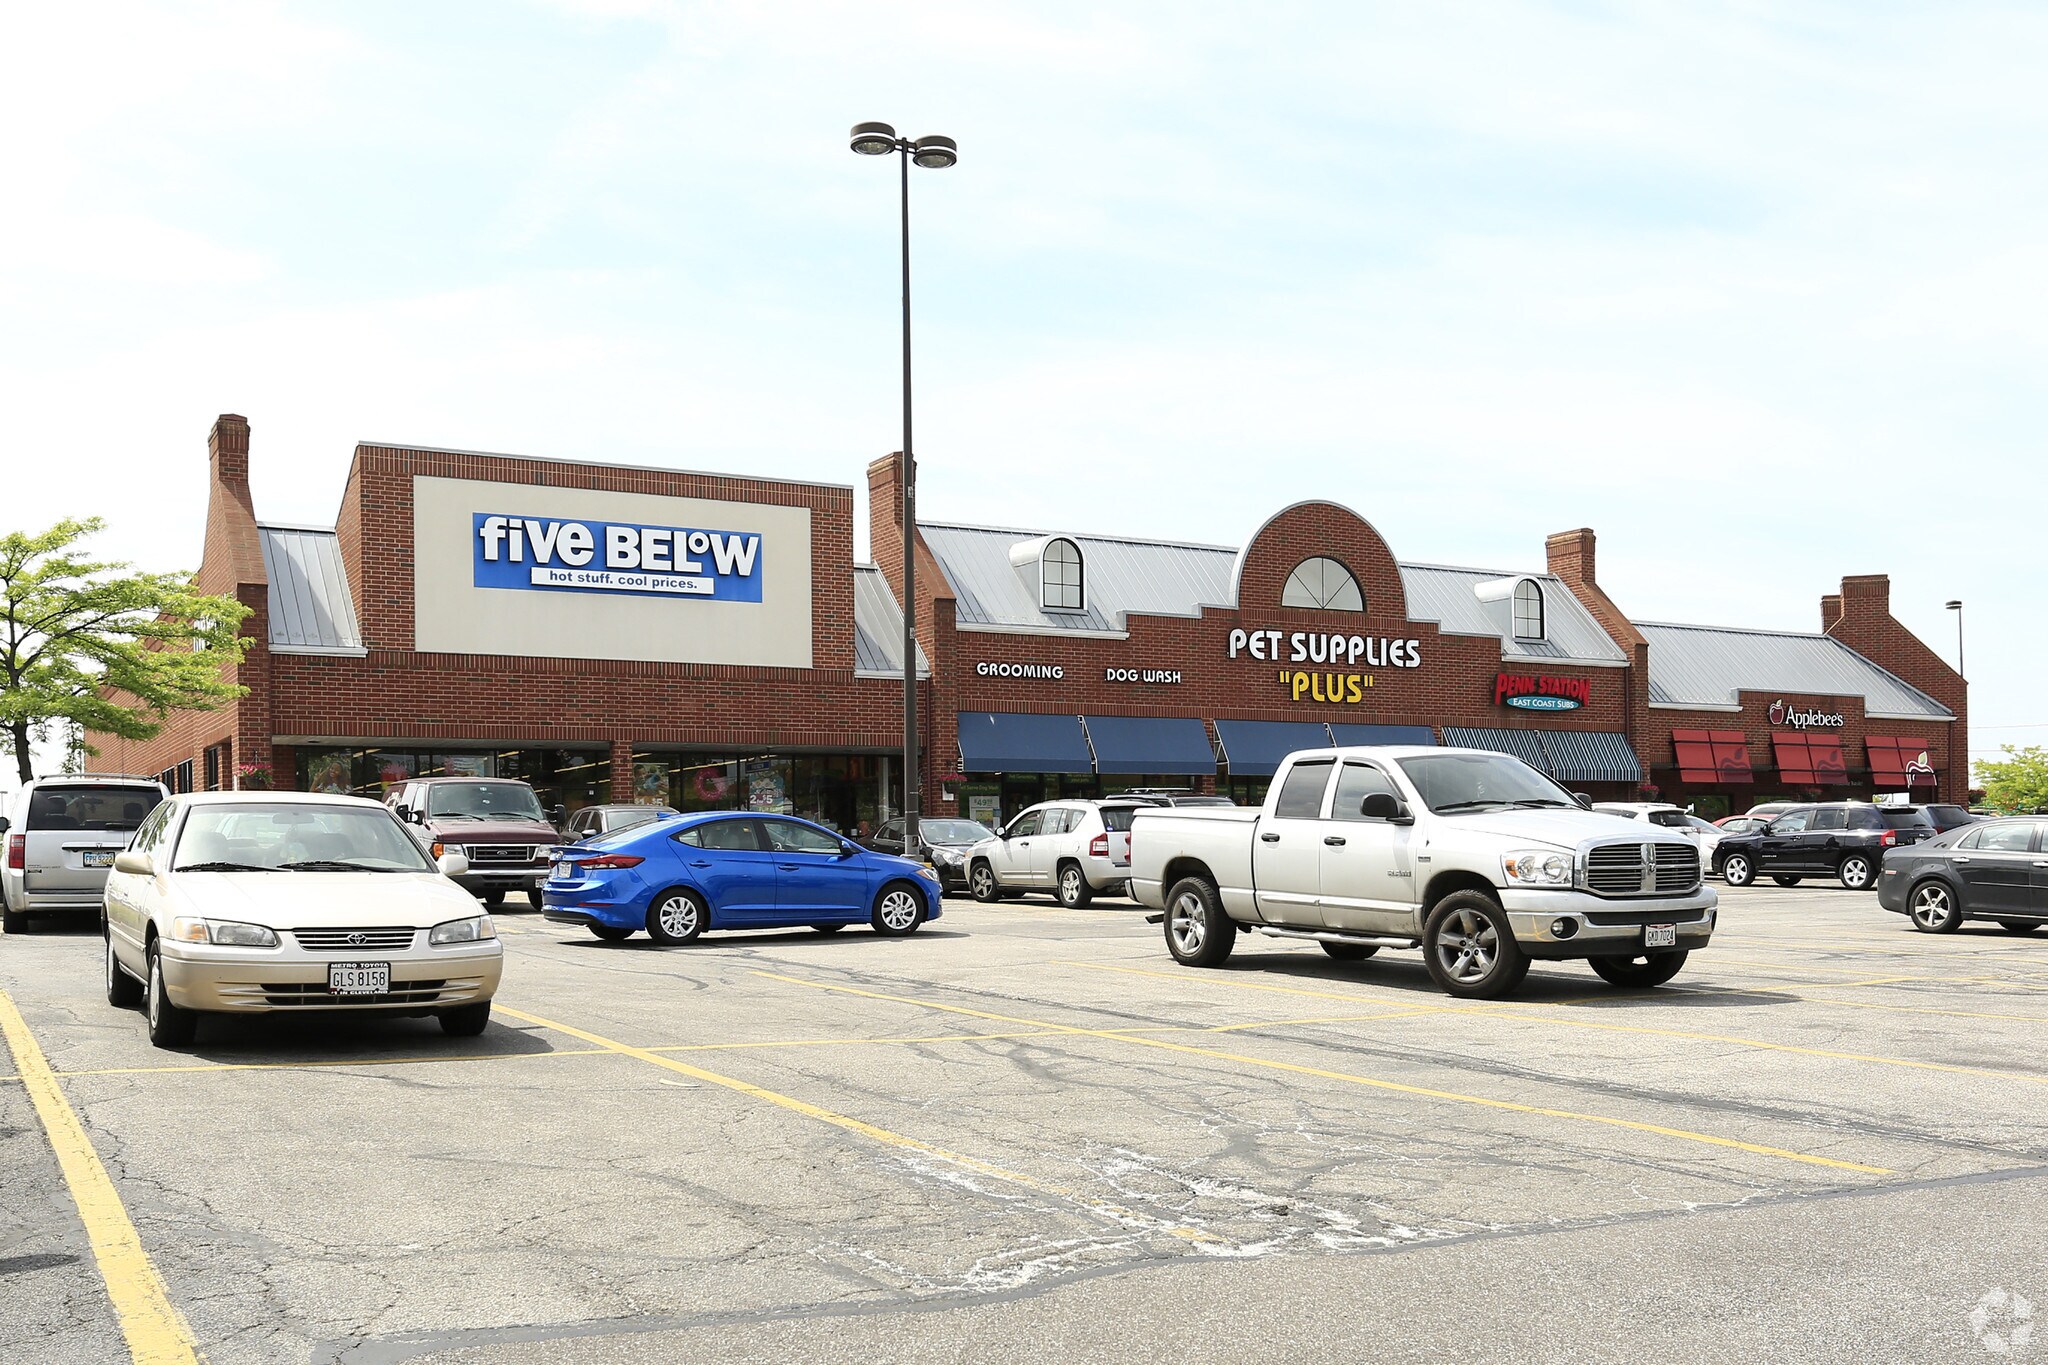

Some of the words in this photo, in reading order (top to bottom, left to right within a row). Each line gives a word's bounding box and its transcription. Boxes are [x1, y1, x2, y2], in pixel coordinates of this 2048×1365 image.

[479, 516, 594, 566] five
[549, 570, 573, 582] hot
[577, 572, 613, 584] stuff.
[618, 576, 647, 586] cool
[652, 577, 698, 589] prices.
[1229, 628, 1283, 661] PET
[1290, 632, 1421, 668] SUPPLIES
[976, 662, 1064, 679] GROOMING
[1106, 668, 1139, 682] DOG
[1143, 669, 1181, 683] WASH
[1279, 670, 1374, 703] "PLUS"
[1494, 672, 1535, 705] PENN
[1538, 675, 1590, 707] STATION
[1513, 698, 1530, 706] EAST
[1532, 699, 1555, 708] COAST
[1557, 700, 1575, 709] SUBS
[1785, 705, 1844, 729] Applebee's
[750, 795, 757, 804] 2
[762, 795, 773, 804] $5
[85, 855, 97, 864] FPH
[98, 855, 113, 864] 9222
[1660, 930, 1674, 941] 7024
[333, 972, 354, 987] GLS
[358, 971, 386, 986] 8158
